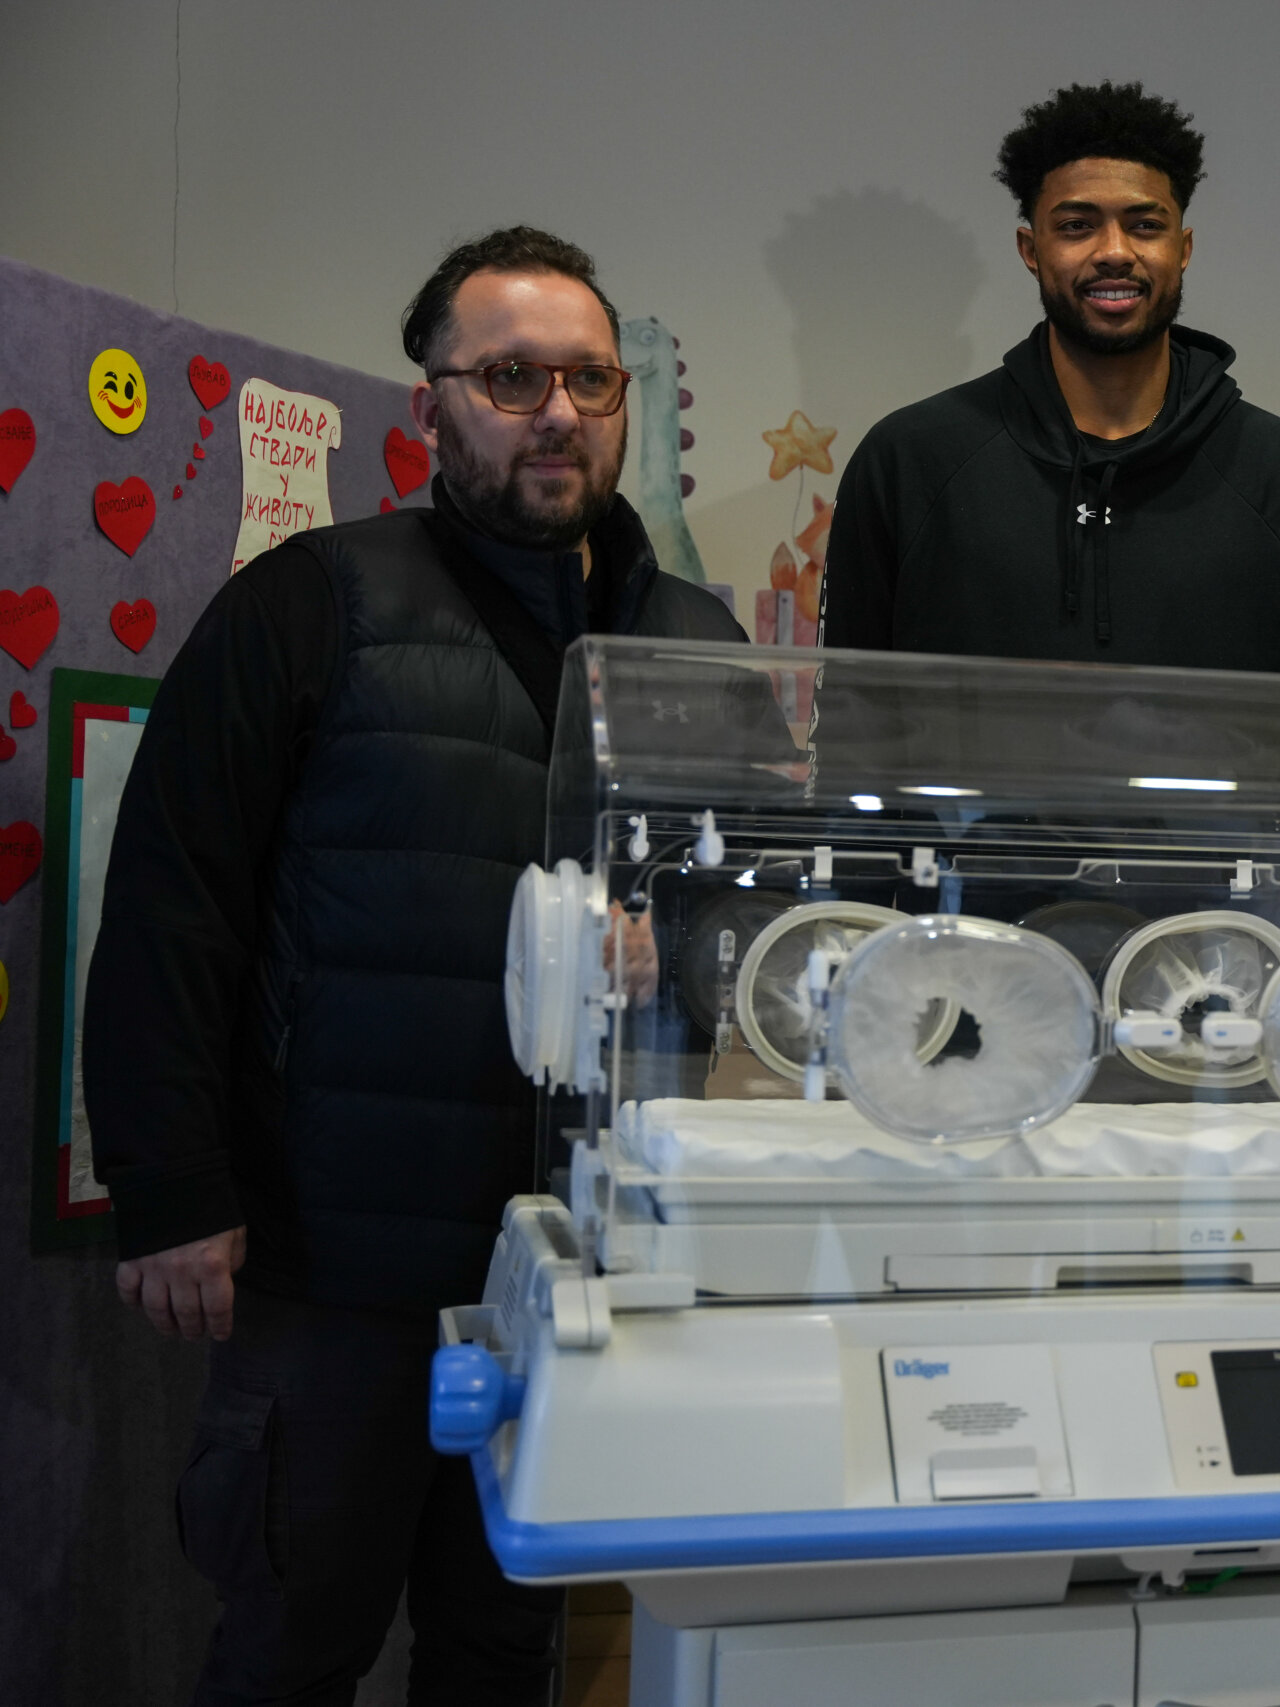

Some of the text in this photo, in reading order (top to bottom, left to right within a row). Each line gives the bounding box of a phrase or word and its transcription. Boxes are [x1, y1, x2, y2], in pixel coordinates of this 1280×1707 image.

[250, 432, 316, 472] СТВАРИ
[279, 474, 289, 497] У
[98, 494, 149, 516] ПОРОДИЦА
[244, 492, 314, 530] ЖИВОТУ
[118, 607, 150, 631] СРЕЋА
[893, 1358, 950, 1379] Dräger
